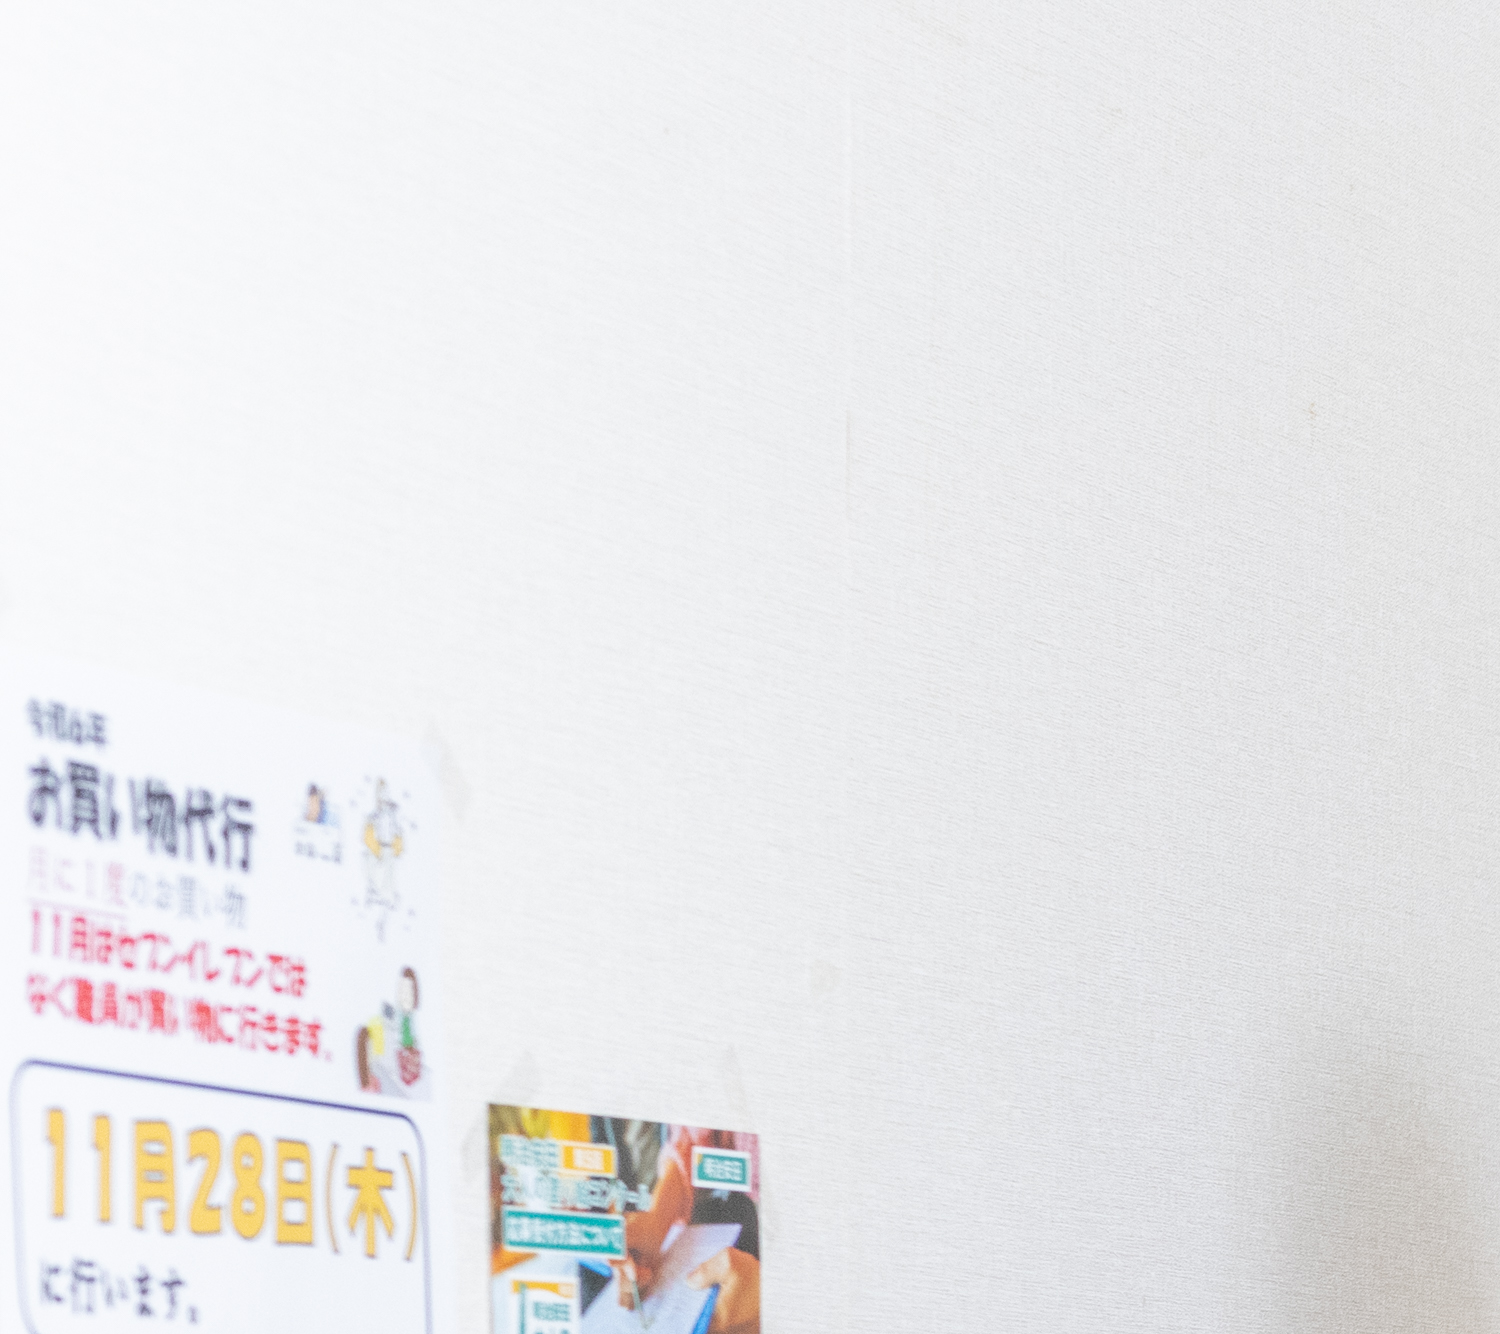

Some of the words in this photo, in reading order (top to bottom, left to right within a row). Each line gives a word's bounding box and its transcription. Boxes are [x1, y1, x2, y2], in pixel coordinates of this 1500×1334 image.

[27, 757, 254, 873] お買い物代行
